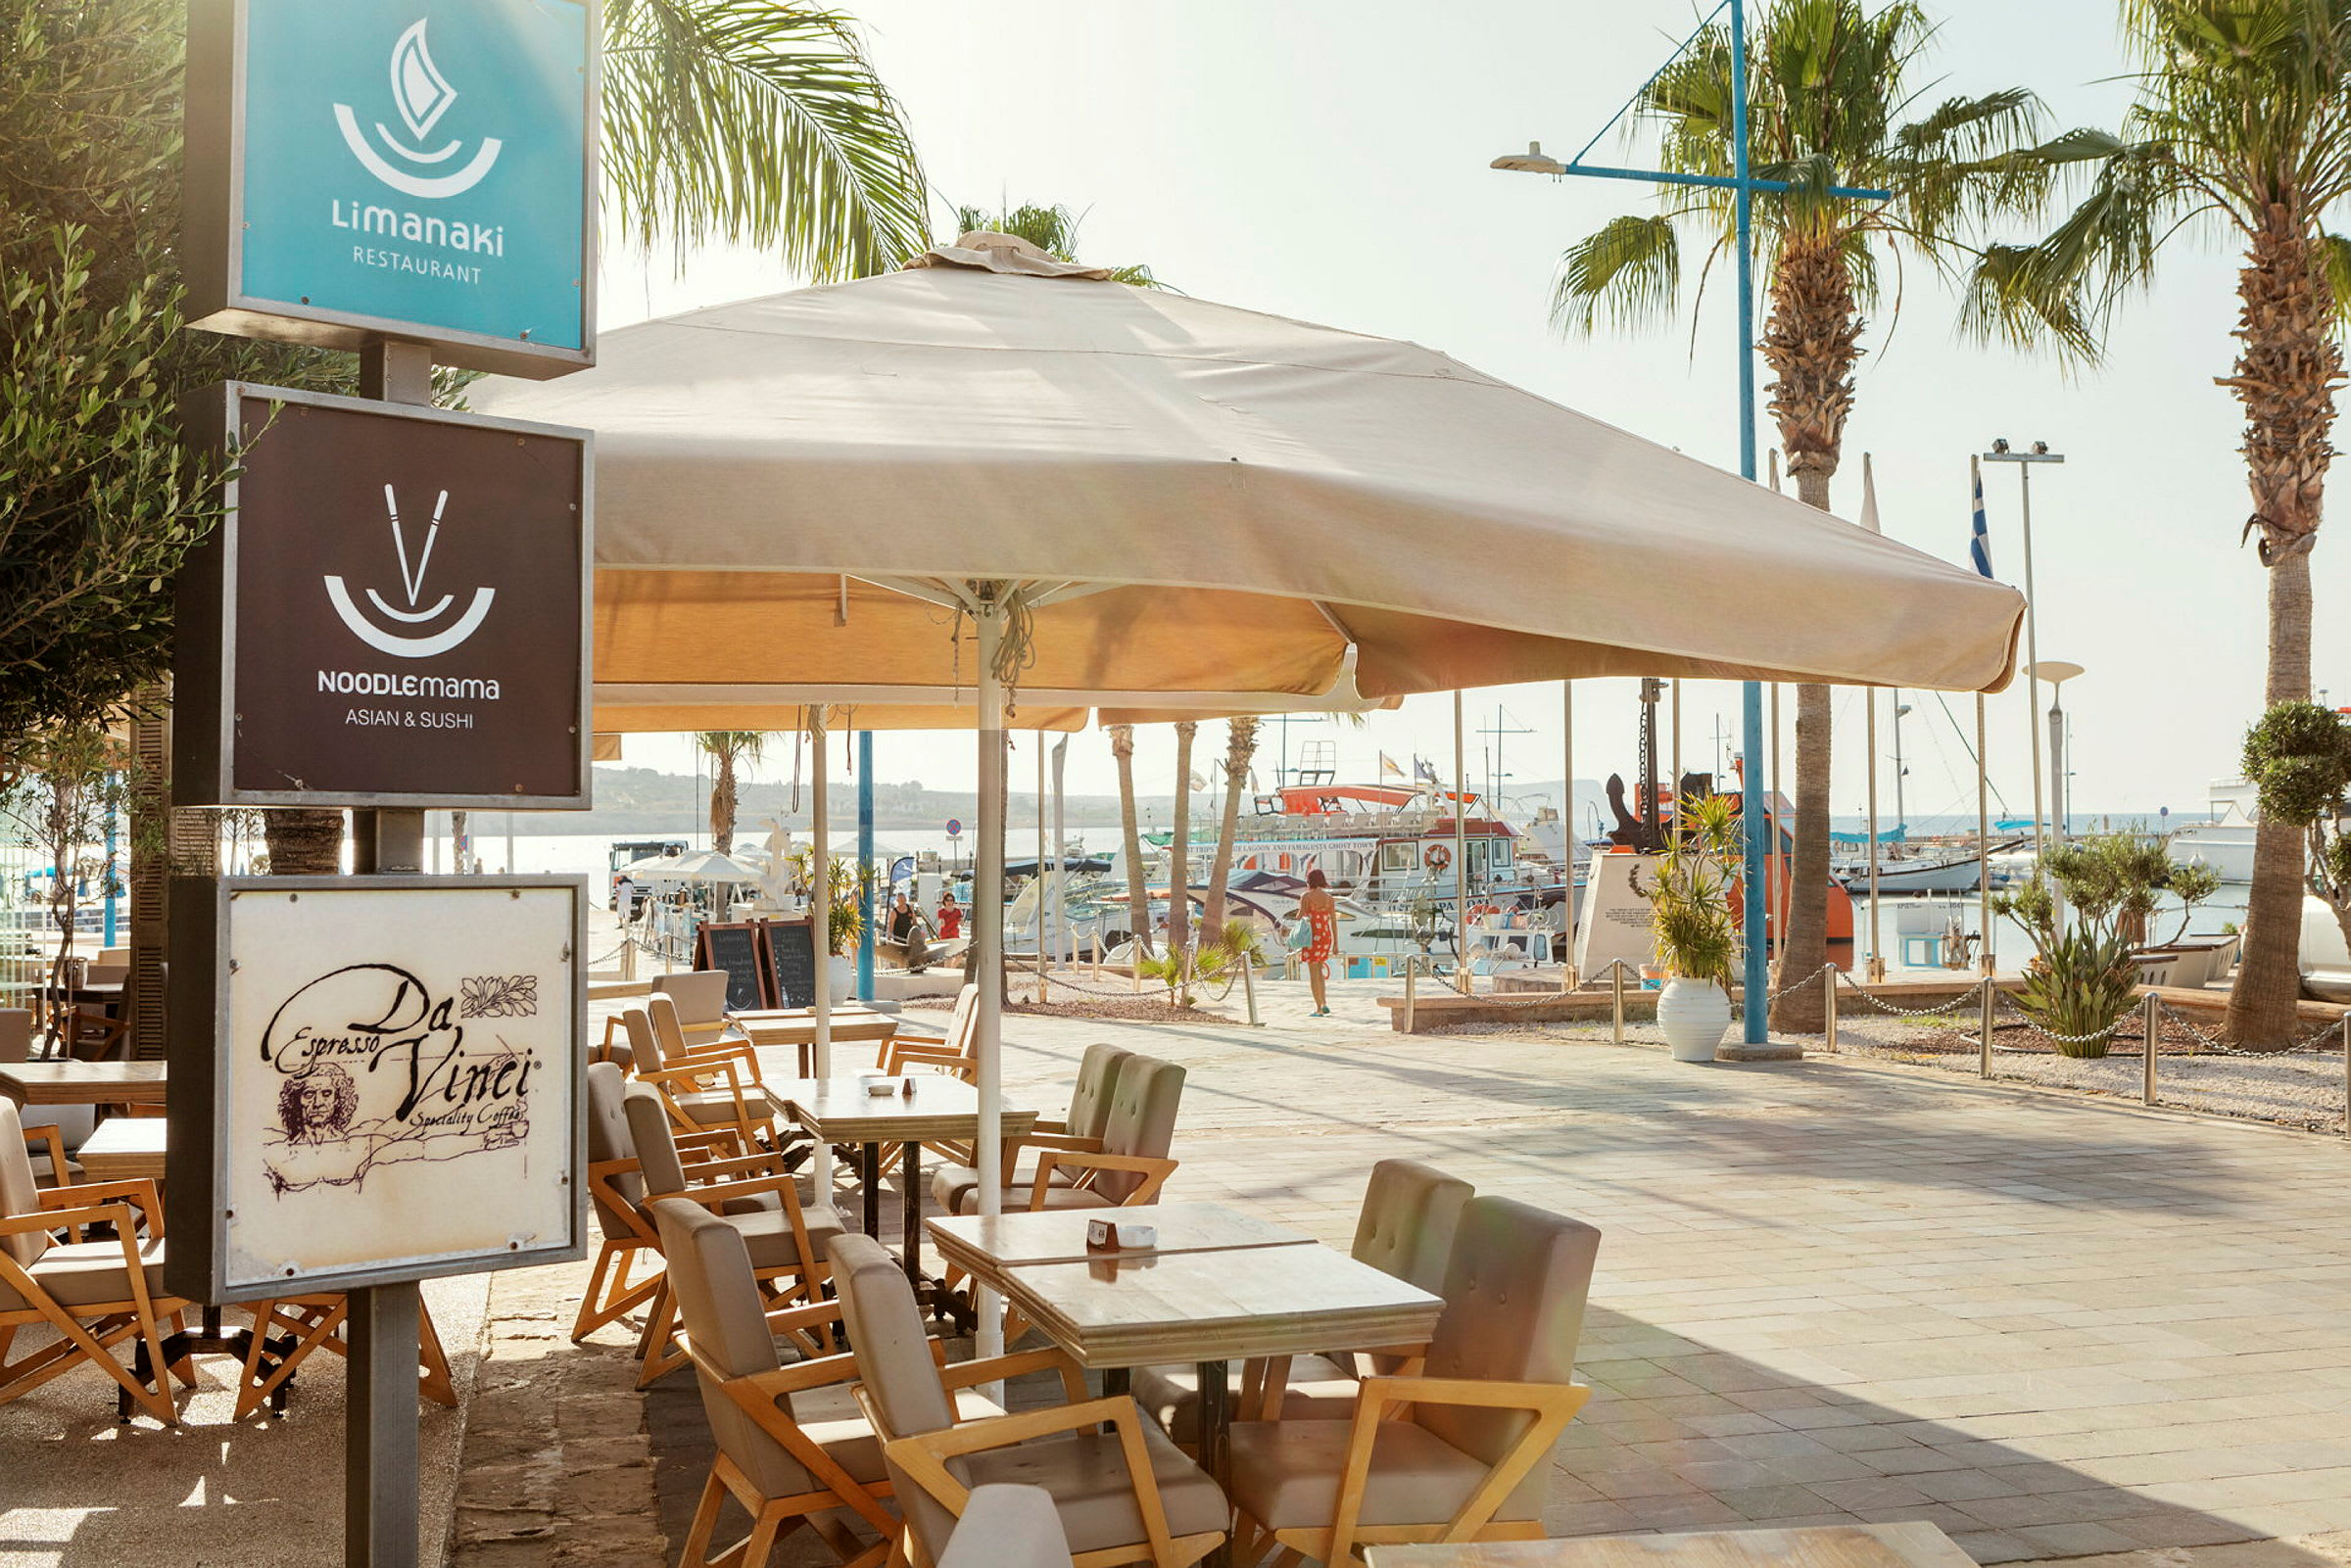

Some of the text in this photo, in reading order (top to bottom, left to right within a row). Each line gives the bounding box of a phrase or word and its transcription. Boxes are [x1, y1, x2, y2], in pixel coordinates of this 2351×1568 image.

[331, 199, 504, 258] Limanaki
[352, 245, 482, 285] RESTAURANT
[316, 670, 501, 700] NOODLEmama
[345, 708, 473, 729] ASIAN & SUSHI
[275, 1026, 381, 1077] Espresso
[369, 1025, 534, 1121] Vinci
[409, 1103, 521, 1138] Speciality Coffee
